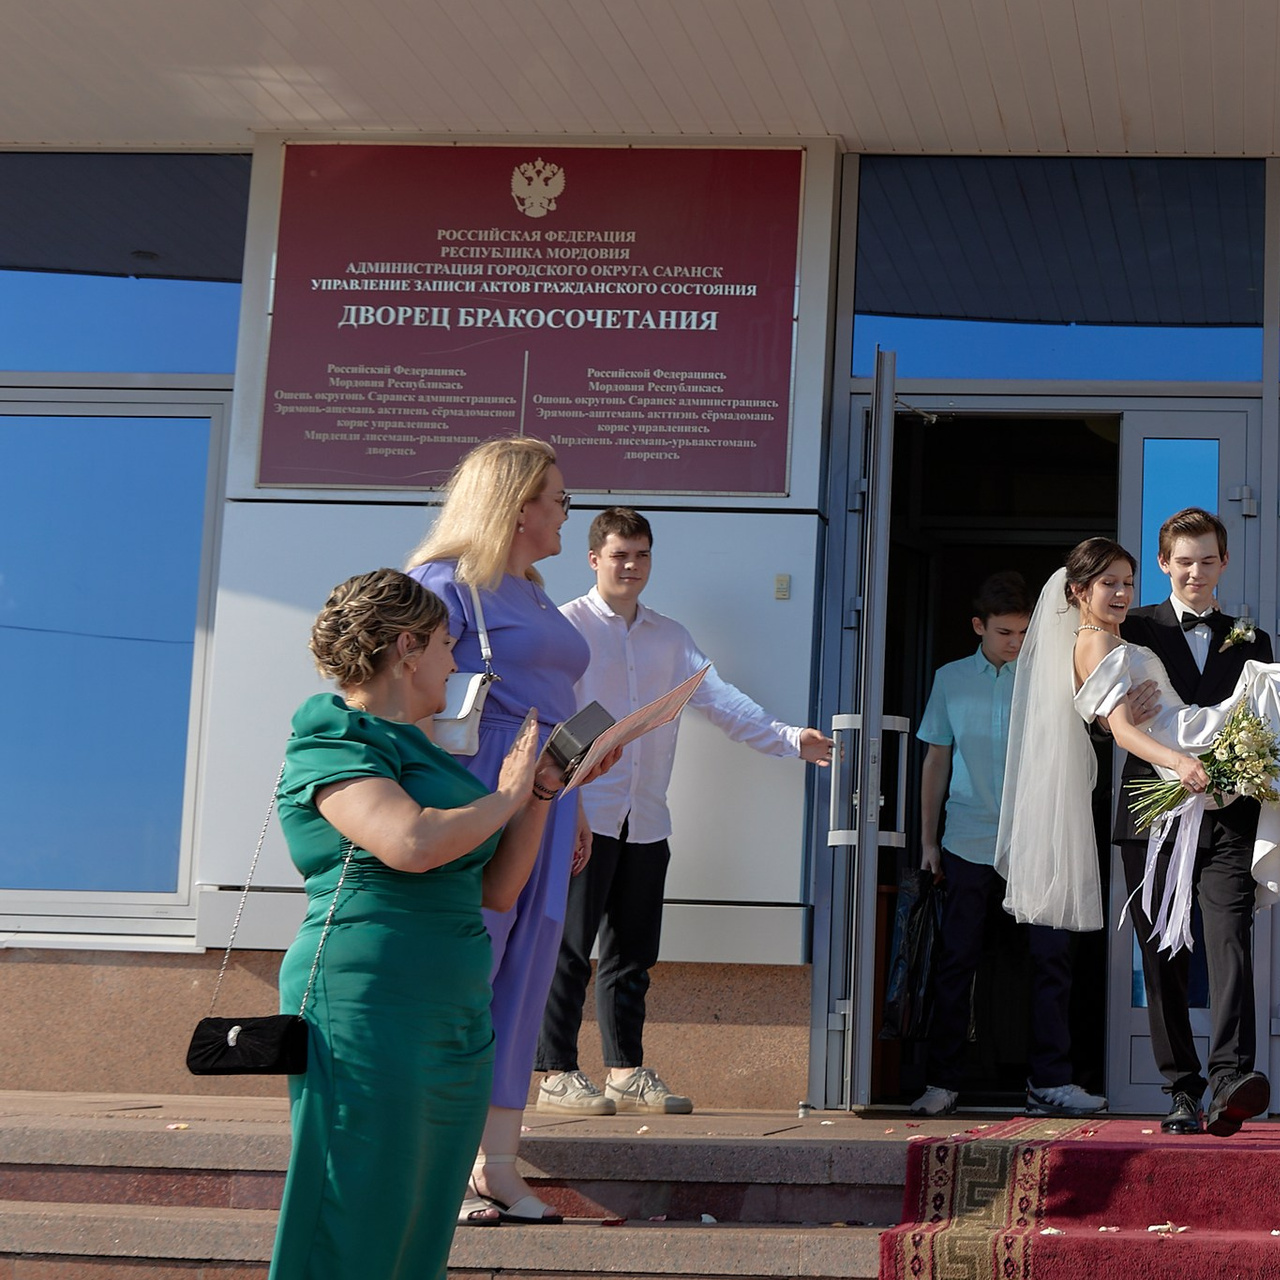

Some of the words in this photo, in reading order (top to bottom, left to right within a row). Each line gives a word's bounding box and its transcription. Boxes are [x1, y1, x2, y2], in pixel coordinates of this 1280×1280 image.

[437, 228, 541, 241] РОССИЙСКАЯ
[545, 231, 636, 243] ФЕДЕРАЦИЯ
[440, 246, 542, 259] РЕСПУБЛИКА
[546, 248, 630, 260] МОРДОВИЯ
[346, 261, 483, 276] АДМИНИСТРАЦИЯ
[487, 264, 587, 277] ГОРОДСКОГО
[590, 264, 649, 278] ОКРУГА
[652, 264, 723, 279] САРАНСК
[311, 279, 410, 293] УПРАВЛЕНИЕ
[414, 280, 475, 294] ЗАПИСИ
[479, 281, 530, 293] АКТОВ
[534, 281, 657, 296] ГРАЖДАНСКОГО
[661, 283, 757, 297] СОСТОЯНИЯ
[338, 305, 450, 329] ДВОРЕЦ
[458, 309, 718, 331] БРАКОСОЧЕТАНИЯ
[393, 366, 467, 377] Федерациясь
[587, 369, 650, 379] Российской
[653, 370, 727, 381] Федерациясь
[329, 378, 384, 389] Мордовия
[388, 379, 463, 390] Республикась
[589, 382, 644, 393] Мордовия
[648, 382, 724, 394] Республикась
[315, 392, 365, 402] округонь
[368, 392, 416, 403] Саранск
[418, 395, 517, 405] администрациясь
[575, 396, 625, 407] округонь
[628, 396, 677, 407] Саранск
[679, 398, 779, 409] администрациясь
[371, 420, 449, 430] управлениясь
[632, 424, 710, 434] управлениясь
